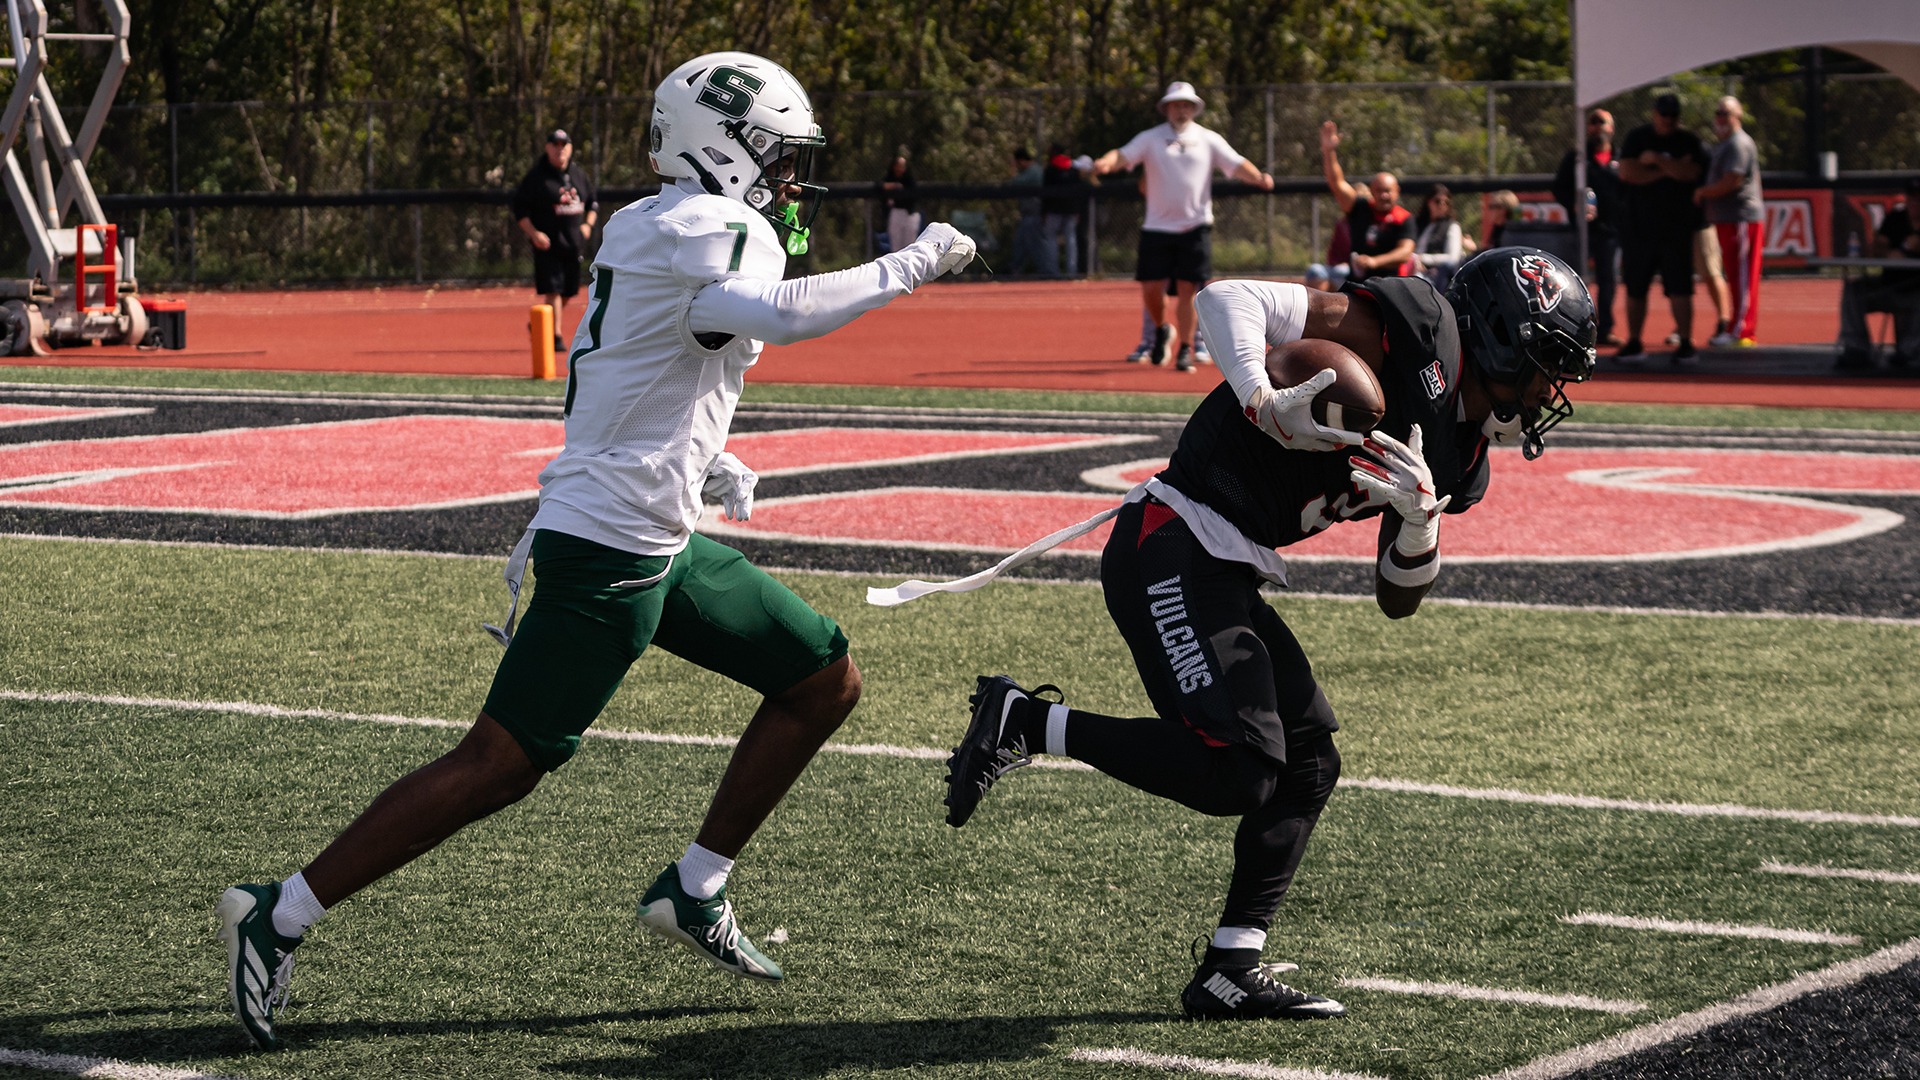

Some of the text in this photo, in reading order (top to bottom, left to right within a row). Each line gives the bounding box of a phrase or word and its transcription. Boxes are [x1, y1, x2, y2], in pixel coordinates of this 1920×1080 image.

[695, 65, 767, 120] S
[724, 221, 748, 272] 7
[564, 266, 614, 419] 7
[1424, 363, 1443, 397] PSAC
[1147, 575, 1213, 694] VULCANS
[1202, 971, 1248, 1009] NIKE
